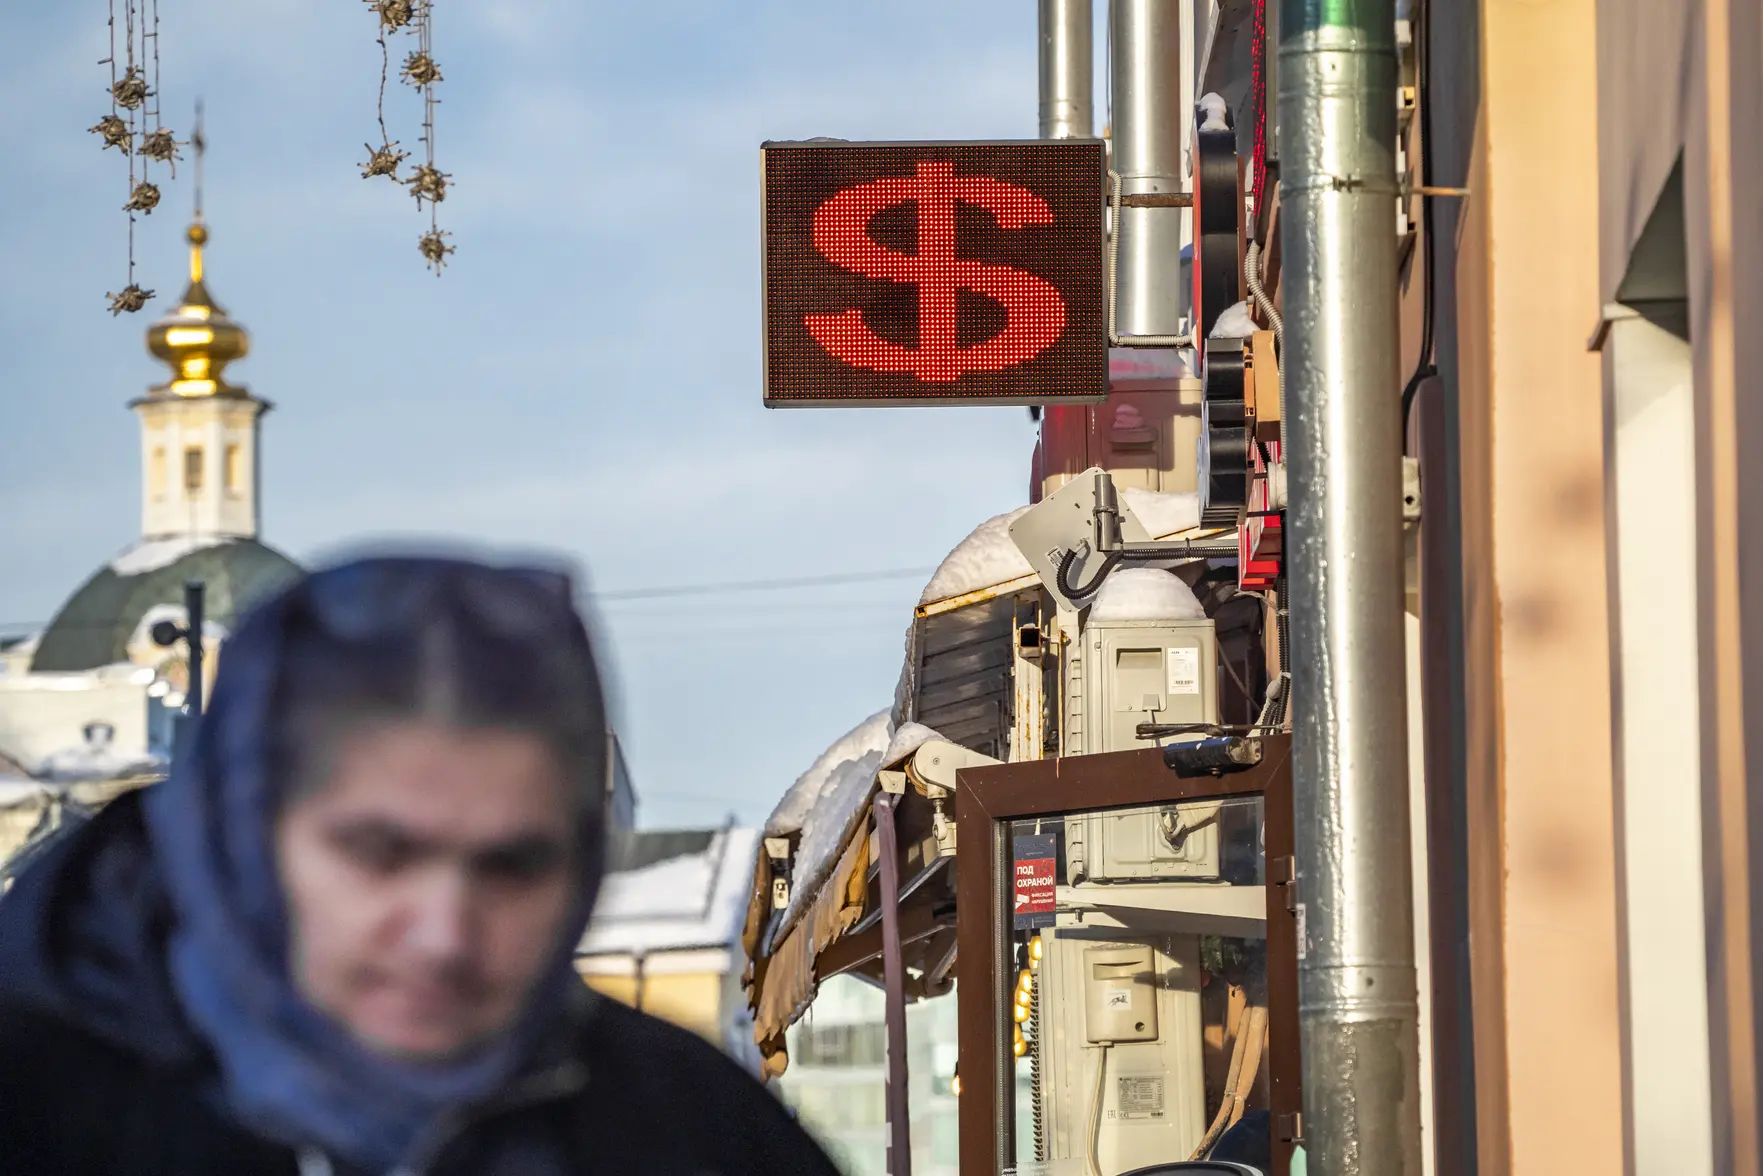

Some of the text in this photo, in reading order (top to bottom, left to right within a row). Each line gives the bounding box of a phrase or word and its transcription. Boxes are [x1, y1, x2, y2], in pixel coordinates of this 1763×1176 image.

[804, 161, 1067, 382] $
[1016, 865, 1034, 875] ПОД
[1016, 875, 1053, 888] ОХРАНОЙ
